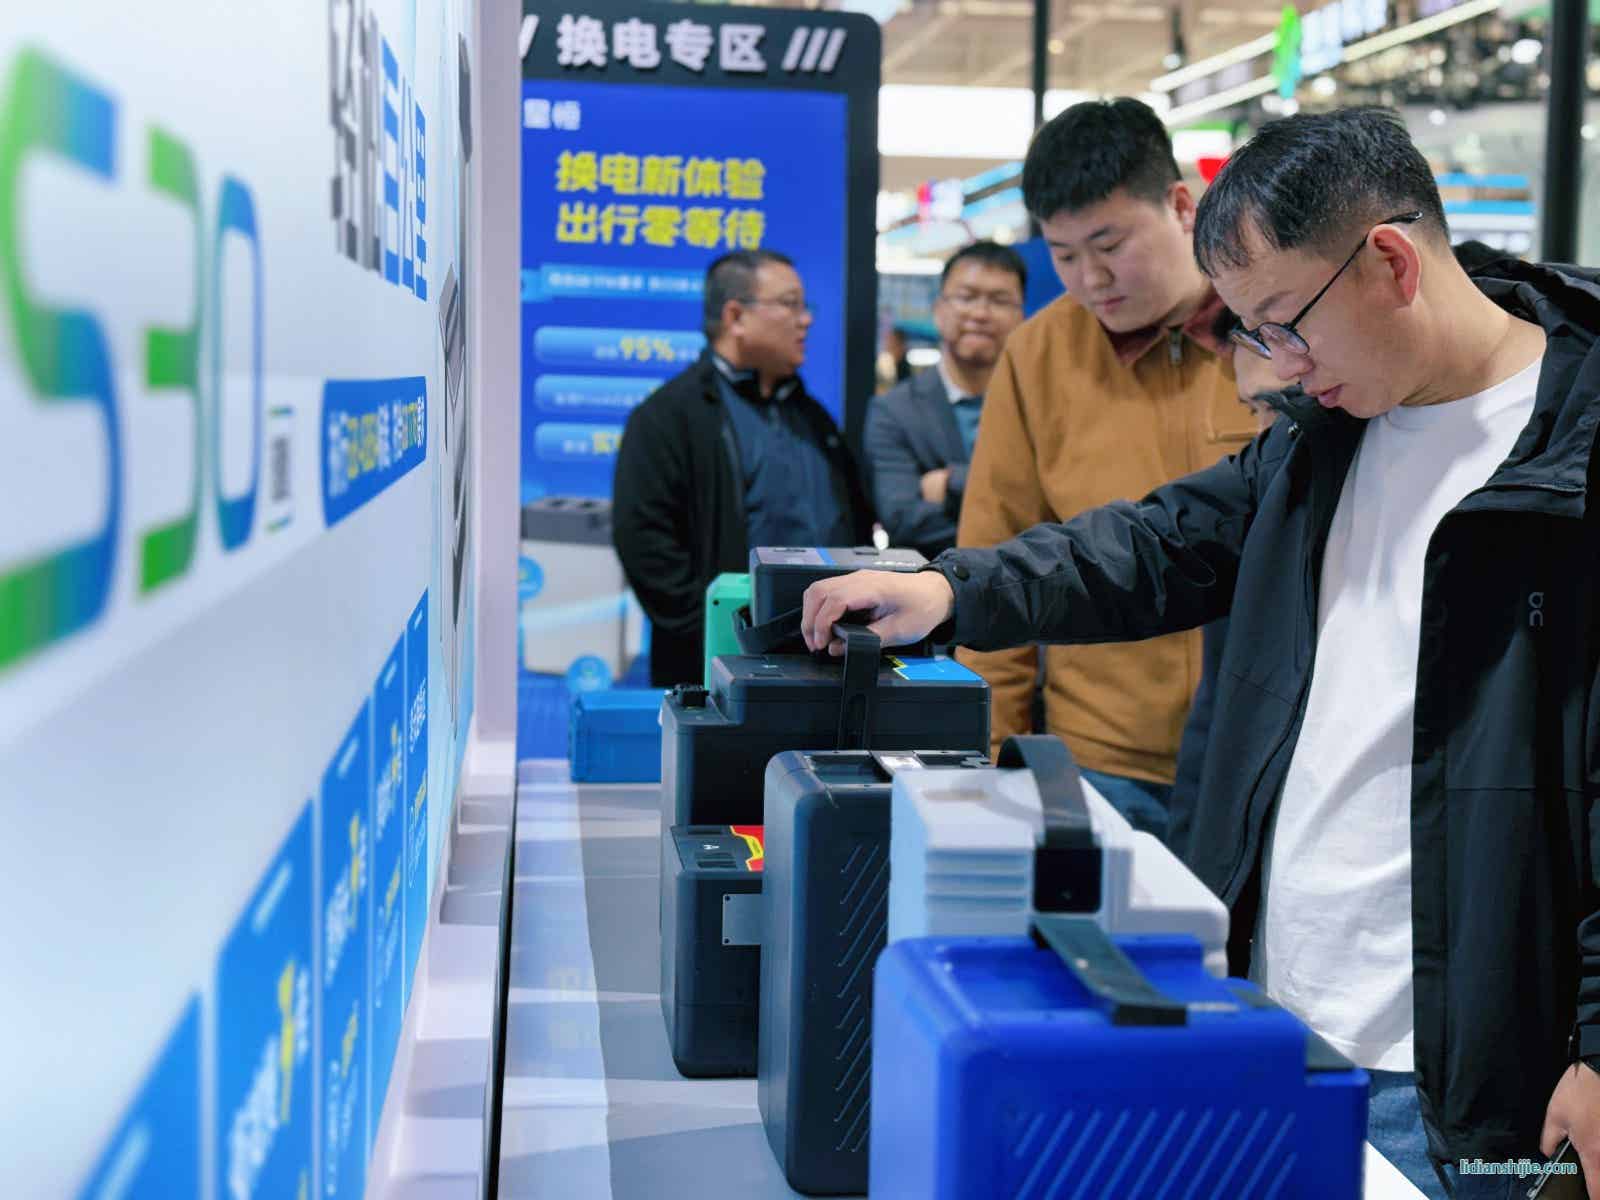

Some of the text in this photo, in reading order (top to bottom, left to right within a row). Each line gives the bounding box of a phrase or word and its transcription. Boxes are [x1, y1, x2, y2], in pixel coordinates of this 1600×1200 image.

[556, 14, 767, 72] 换电专区
[555, 150, 766, 200] 换电新体验
[555, 202, 766, 251] 出行零等待
